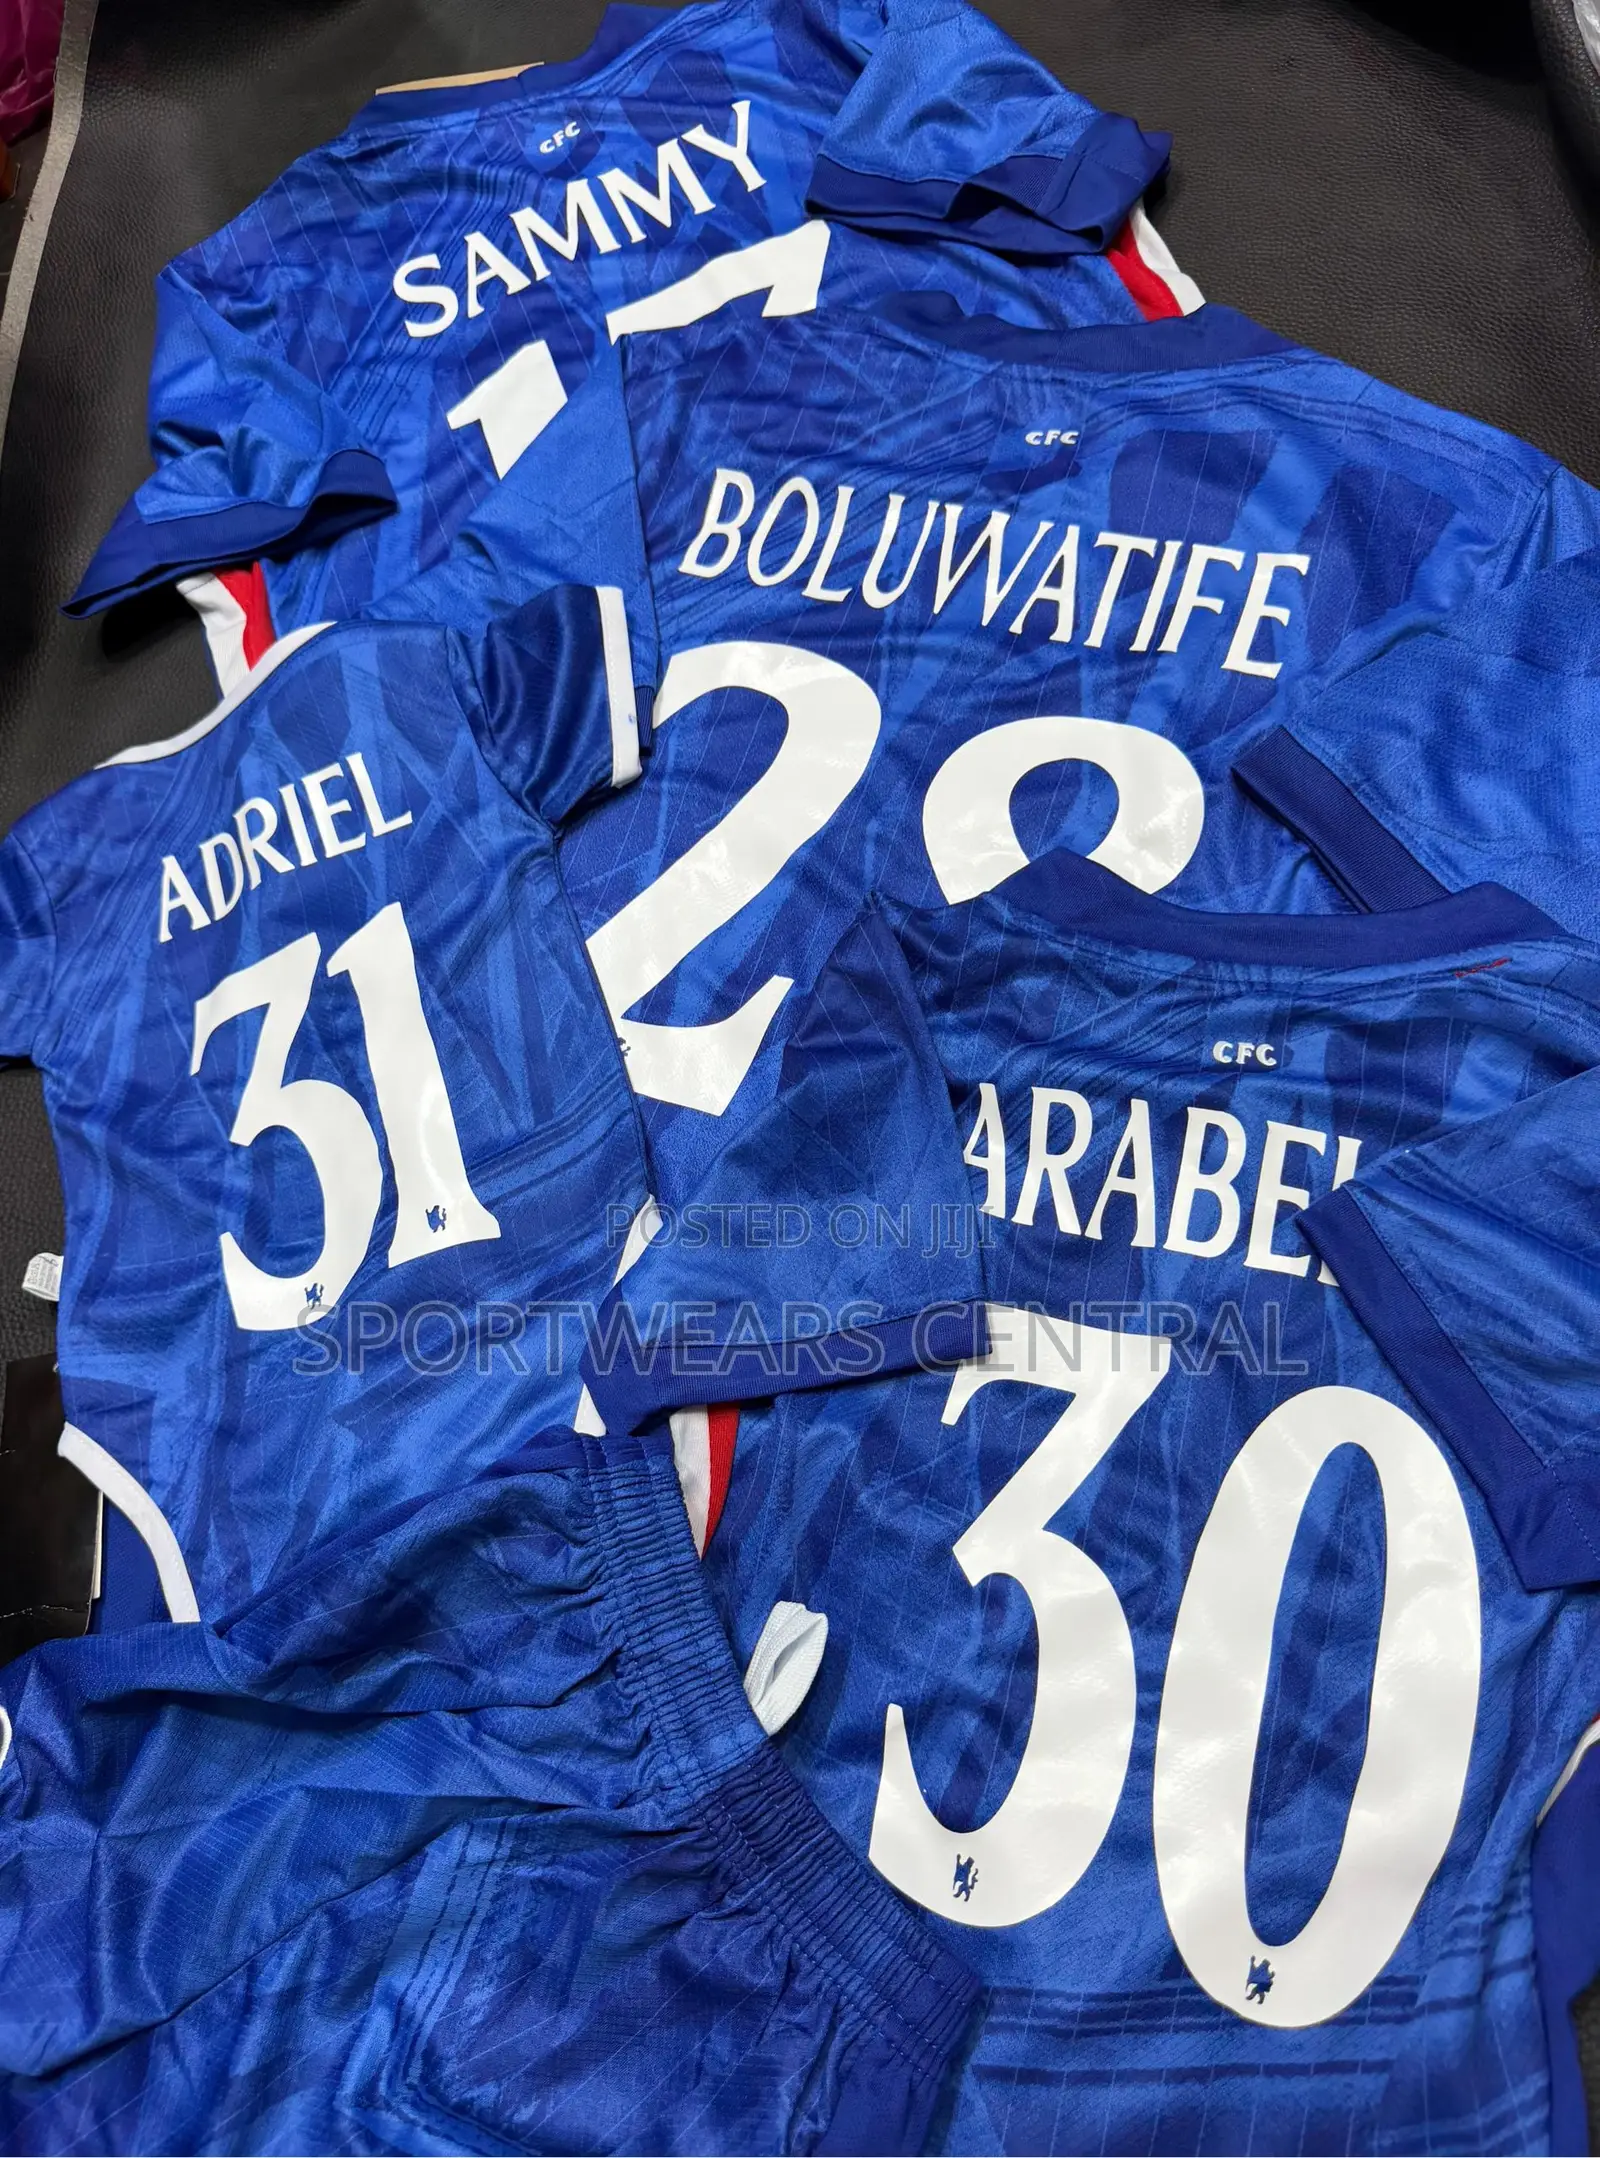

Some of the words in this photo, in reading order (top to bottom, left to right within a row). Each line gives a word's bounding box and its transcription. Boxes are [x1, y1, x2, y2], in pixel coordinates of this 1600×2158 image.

[393, 100, 767, 338] SAMMY
[540, 121, 581, 154] CFC
[1025, 429, 1079, 446] CFC
[678, 468, 1311, 680] BOLUWATIFE
[159, 752, 413, 943] ADRIEL
[190, 902, 501, 1331] 31
[1213, 1040, 1277, 1067] CFC
[868, 1306, 1483, 2028] 30
